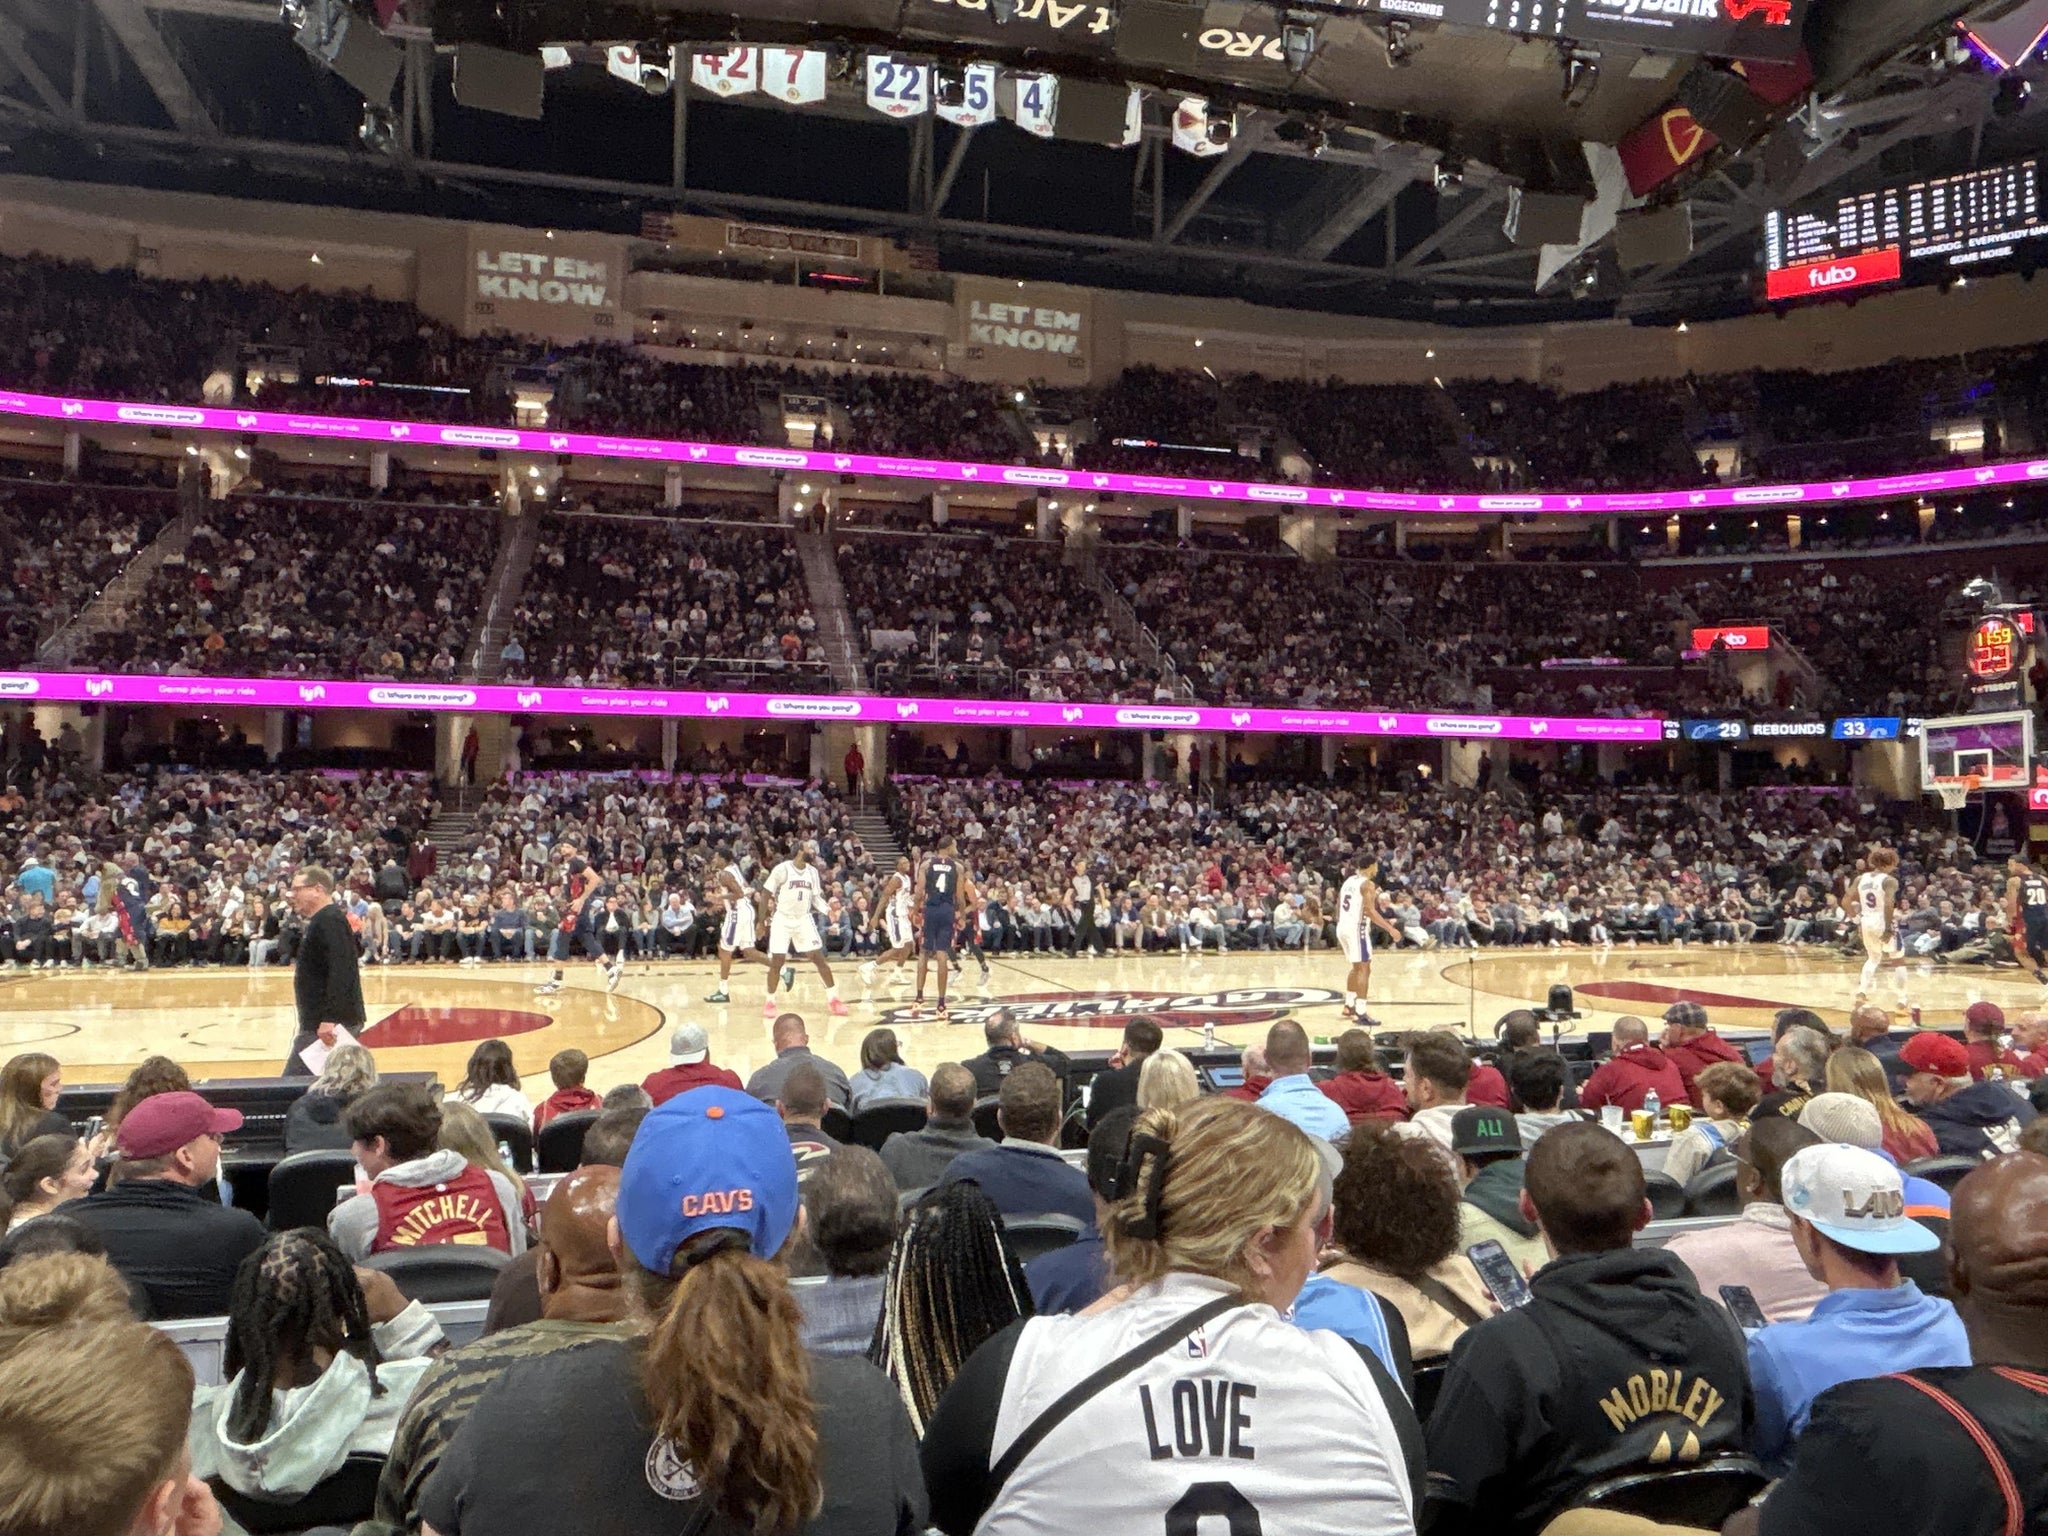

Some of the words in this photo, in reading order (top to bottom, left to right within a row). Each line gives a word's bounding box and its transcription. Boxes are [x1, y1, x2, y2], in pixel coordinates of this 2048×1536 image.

[784, 49, 804, 84] 7
[874, 61, 921, 101] 22
[967, 73, 989, 110] 5
[1022, 83, 1044, 118] 4
[1968, 228, 2029, 247] EVERYBODY
[477, 251, 548, 275] LET
[553, 256, 607, 281] EM
[1949, 252, 1979, 265] SOME
[1808, 265, 1857, 288] fubo
[970, 301, 1030, 324] LET
[1034, 308, 1081, 331] EM
[1974, 645, 2011, 674] 23
[1, 681, 29, 690] going?
[86, 679, 113, 696] lyft
[159, 684, 189, 694] Game
[190, 686, 212, 695] plan
[212, 687, 235, 696] your
[237, 687, 256, 696] ride
[299, 685, 326, 702] lyft
[443, 693, 467, 702] going?
[517, 692, 542, 708] lyft
[706, 697, 729, 713] lyft
[832, 704, 853, 713] going?
[1665, 729, 1679, 739] 53
[1719, 723, 1741, 738] 29
[1753, 723, 1826, 736] REBOUNDS
[1843, 722, 1866, 736] 33
[935, 873, 946, 893] 4
[1342, 894, 1352, 912] 5
[1866, 892, 1877, 908] 9
[2027, 888, 2047, 905] 20
[682, 1188, 753, 1218] CAVS
[390, 1194, 493, 1246] MITCHELL
[1599, 1368, 1725, 1433] MOBLEY
[1139, 1378, 1257, 1461] LOVE
